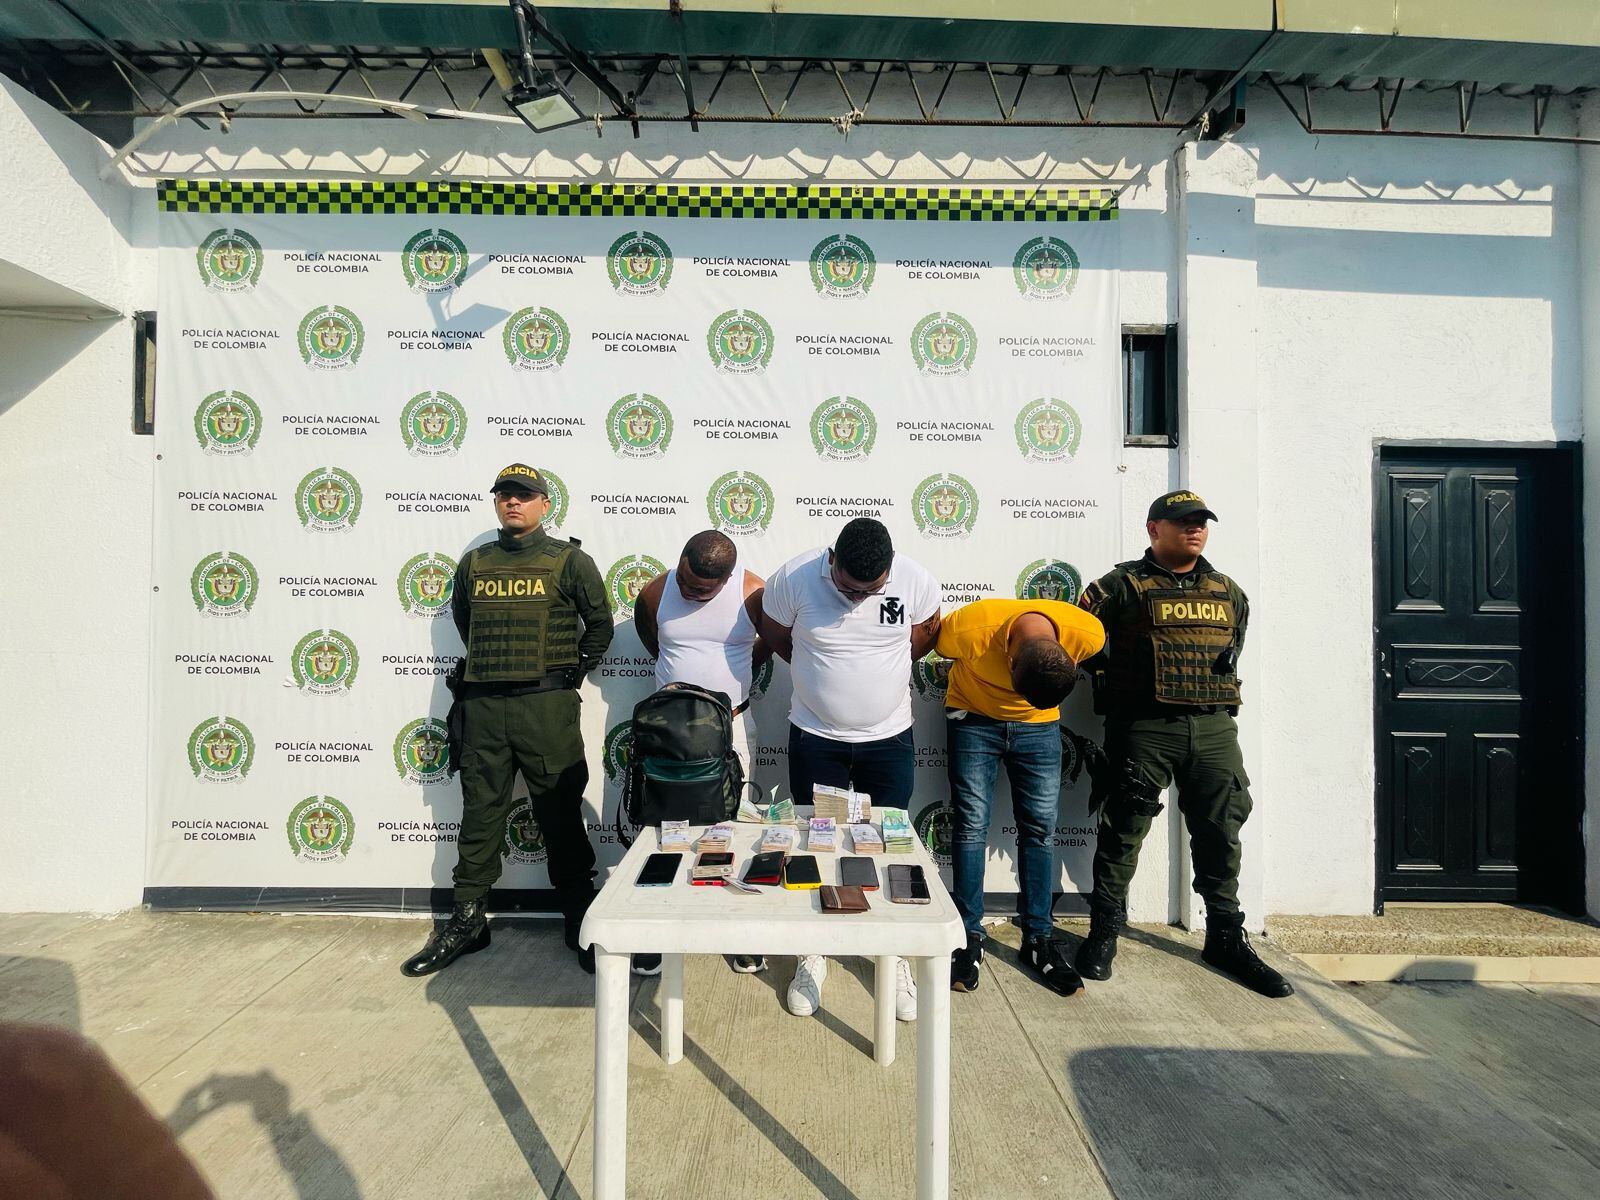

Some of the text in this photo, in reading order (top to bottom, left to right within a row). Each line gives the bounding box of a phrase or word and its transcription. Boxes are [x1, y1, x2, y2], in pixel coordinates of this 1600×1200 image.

[284, 252, 325, 261] POLICÍA
[489, 253, 530, 263] POLICÍA
[694, 256, 734, 265] POLICÍA
[896, 258, 936, 268] POLICÍA
[722, 269, 777, 277] COLOMBIA
[183, 328, 223, 337] POLICÍA
[388, 329, 429, 339] POLICÍA
[592, 331, 633, 340] POLICÍA
[796, 334, 837, 343] POLICÍA
[999, 336, 1095, 346] POLICÍA NACIONAL
[283, 414, 324, 424] POLICÍA
[488, 415, 529, 425] POLICÍA
[694, 418, 735, 427] POLICÍA
[897, 420, 938, 430] POLICÍA
[496, 466, 538, 480] POLICIA
[179, 490, 220, 500] POLICÍA
[386, 491, 427, 501] POLICÍA
[591, 493, 632, 503] POLICÍA
[796, 496, 837, 505] POLICÍA
[1001, 498, 1042, 507] POLICÍA
[280, 576, 321, 585] POLICÍA
[474, 579, 546, 596] POLICIA
[1161, 603, 1228, 622] POLICIA
[176, 653, 217, 662] POLICÍA
[382, 654, 424, 663] POLICÍA
[275, 741, 316, 750] POLICÍA
[172, 819, 213, 828] POLICÍA
[378, 821, 420, 830] POLICÍA
[1054, 827, 1098, 835] ACIONAL
